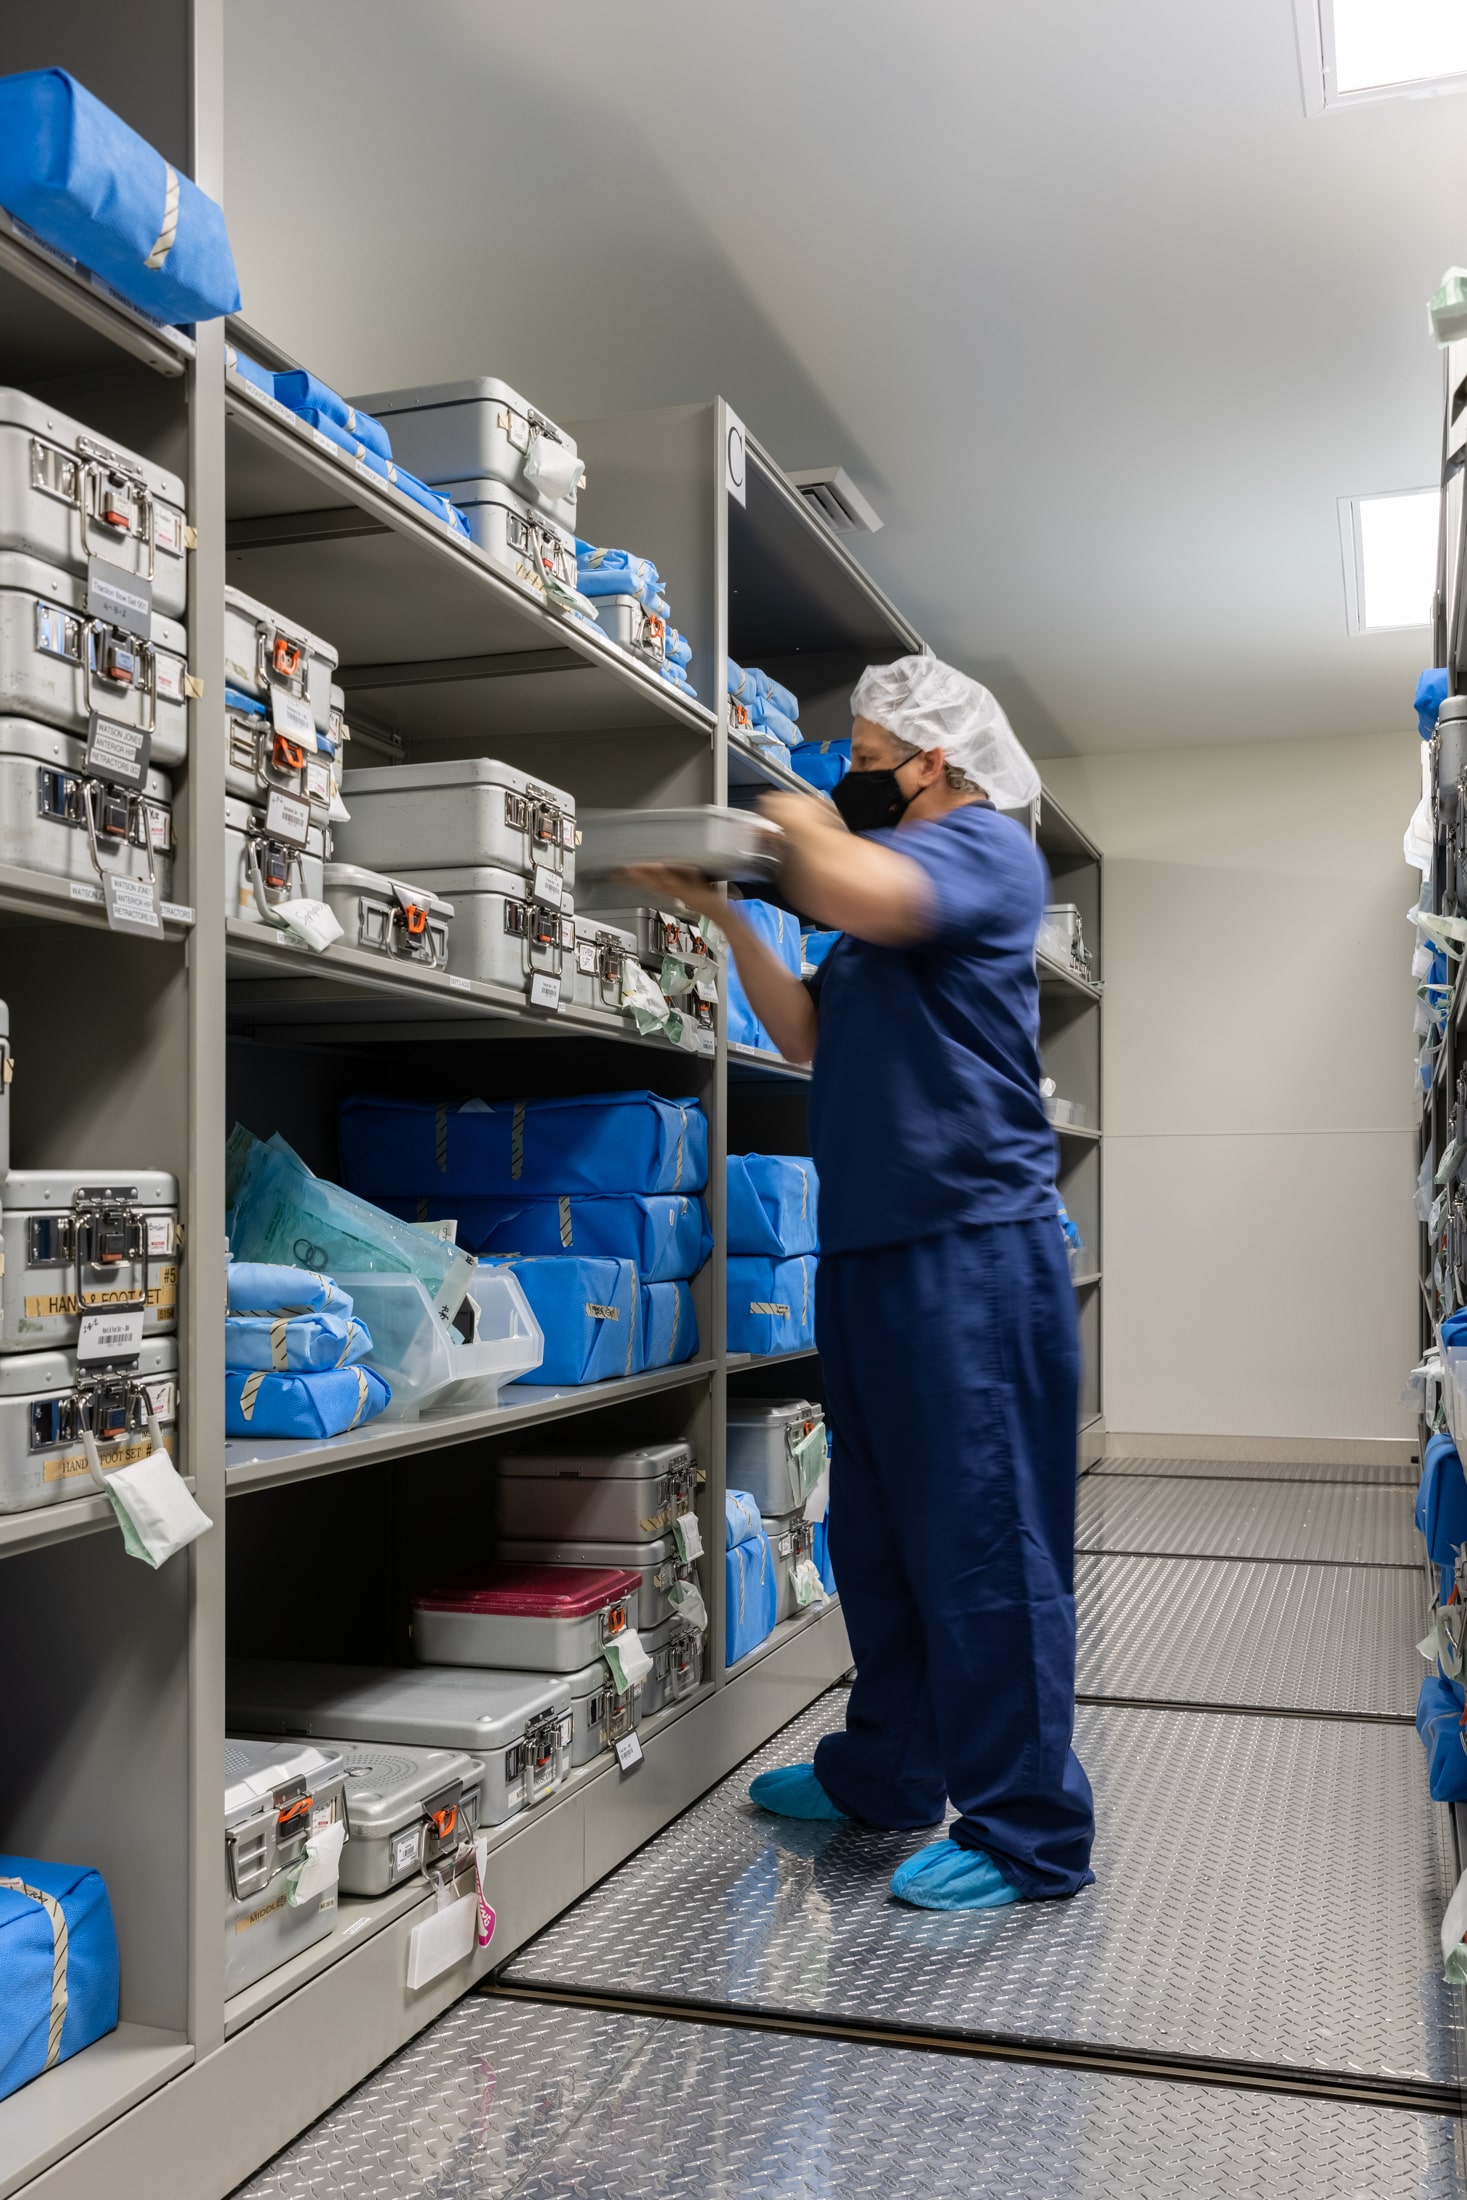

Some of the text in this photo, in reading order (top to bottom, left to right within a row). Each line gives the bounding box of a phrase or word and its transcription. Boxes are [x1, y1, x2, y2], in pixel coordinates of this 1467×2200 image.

[728, 426, 743, 487] C
[98, 723, 142, 746] WATSON JONES
[96, 738, 136, 757] ANTERIOR HIP
[92, 751, 130, 772] RETRACTORS
[72, 887, 98, 900] WATSON
[113, 879, 152, 896] WATSON JONES
[118, 895, 152, 908] ANTERIOR HIP
[114, 906, 149, 920] RETRACTORS
[160, 904, 192, 919] ETRACTORS
[164, 1267, 176, 1283] #5
[62, 1460, 88, 1473] HAND
[100, 1451, 124, 1465] FOOT
[125, 1447, 141, 1459] SET
